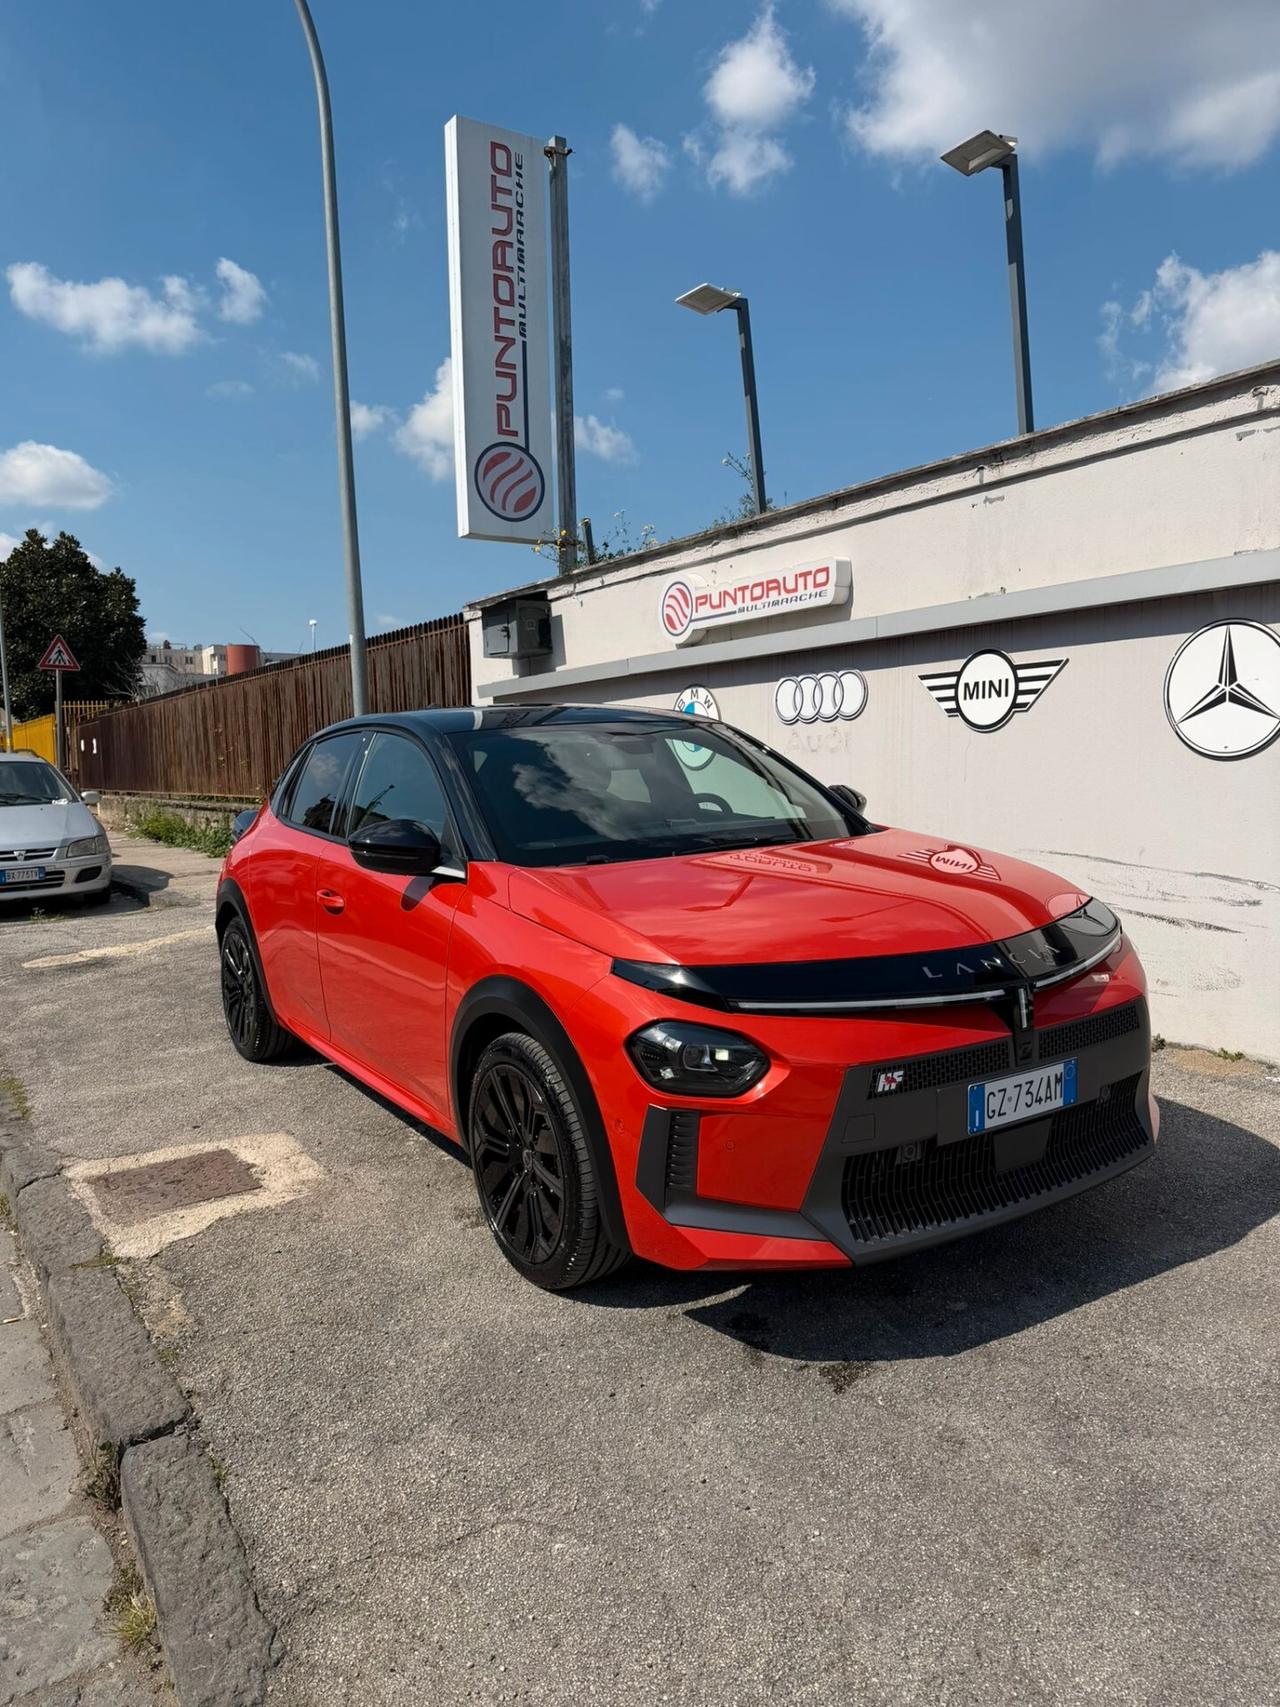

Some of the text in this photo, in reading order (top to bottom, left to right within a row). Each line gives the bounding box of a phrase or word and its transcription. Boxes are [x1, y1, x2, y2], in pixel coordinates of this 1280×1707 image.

[515, 152, 527, 339] MULTIMARCHE
[490, 141, 518, 437] PUNTOAUTO
[695, 566, 830, 613] PUNTOAUTO
[737, 589, 828, 614] MULTIMARCHE
[678, 689, 713, 711] BMW
[963, 678, 1009, 701] MINI
[921, 944, 1061, 979] LANCIA
[877, 1070, 905, 1093] HF
